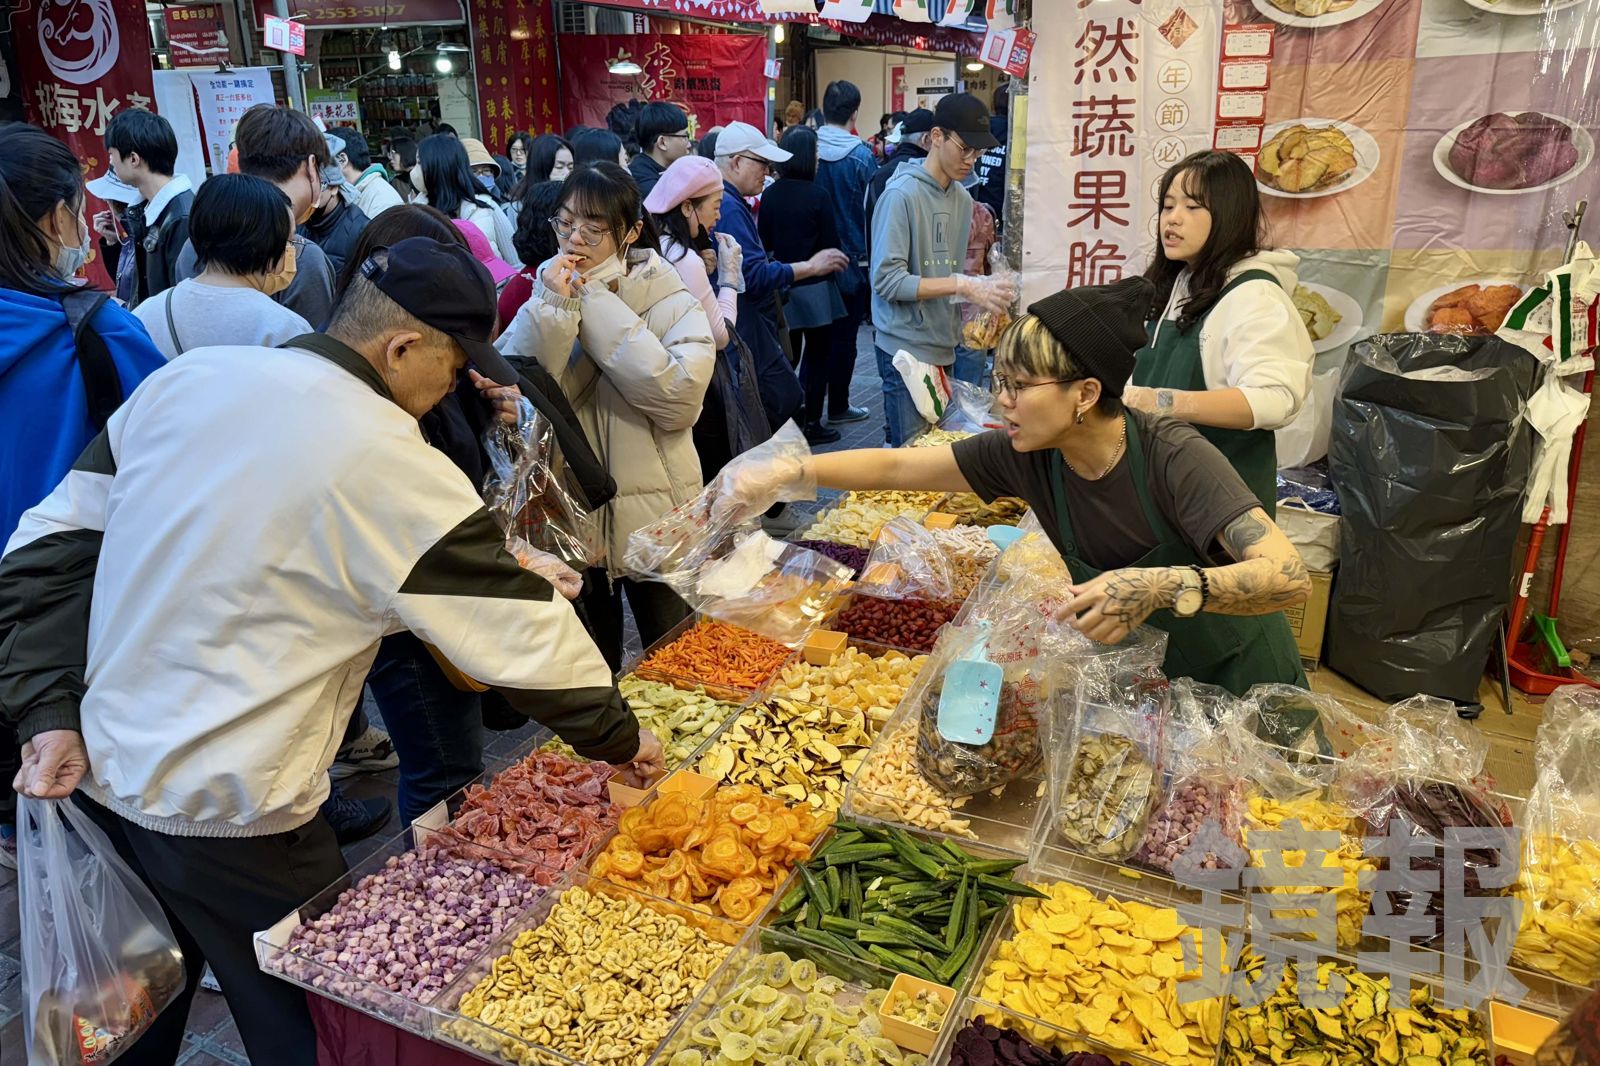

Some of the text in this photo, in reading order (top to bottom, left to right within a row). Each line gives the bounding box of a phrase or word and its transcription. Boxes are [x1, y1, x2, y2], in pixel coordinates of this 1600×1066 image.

[315, 5, 405, 19] 2553-5197
[1066, 0, 1142, 289] 然蔬果脆
[1156, 67, 1187, 199] 年節必
